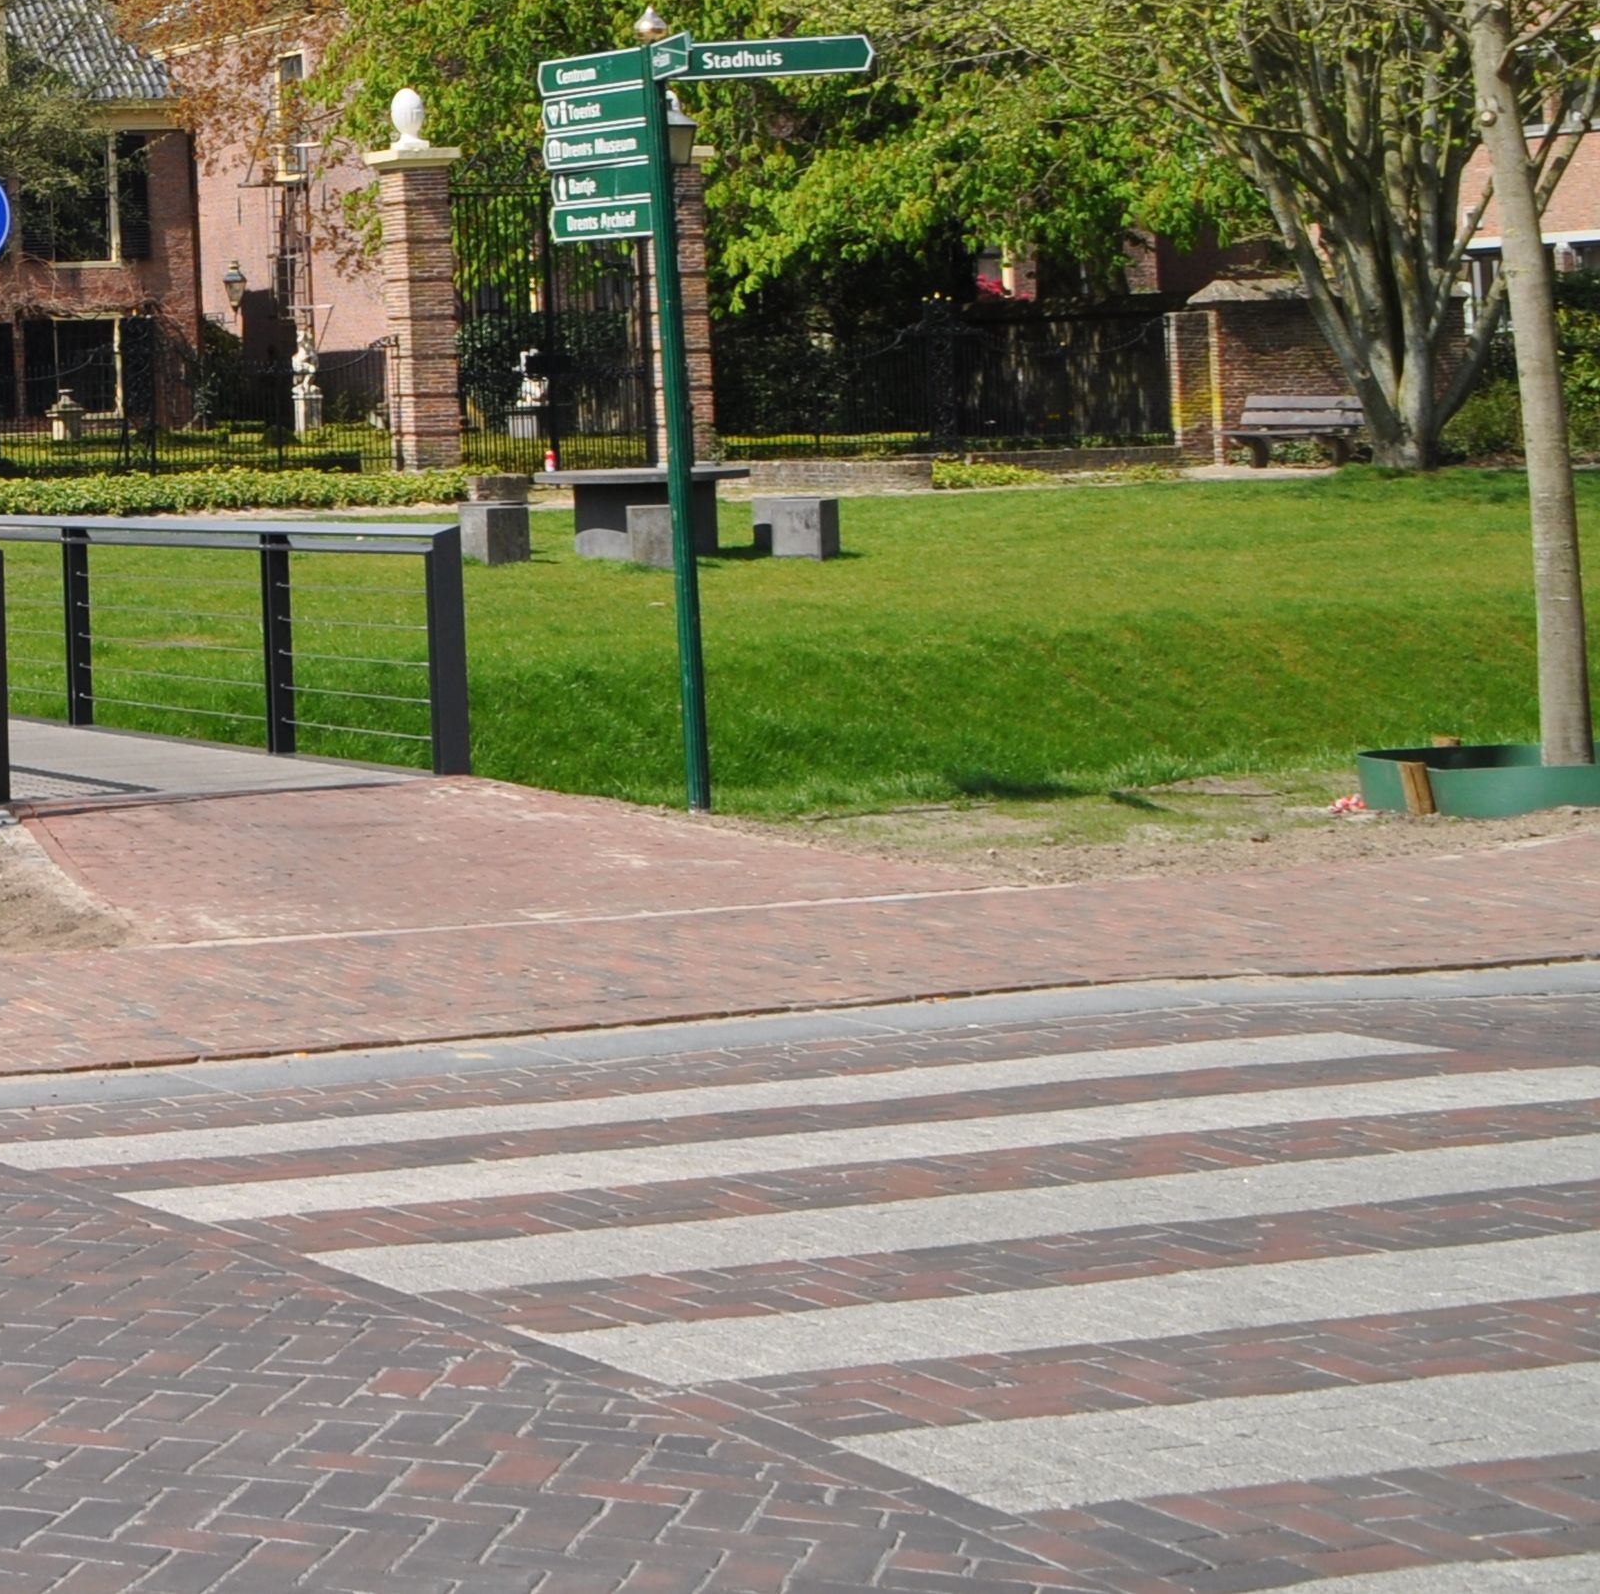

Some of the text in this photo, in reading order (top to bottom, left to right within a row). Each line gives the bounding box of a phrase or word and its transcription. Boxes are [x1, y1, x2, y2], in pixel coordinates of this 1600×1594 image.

[701, 49, 783, 70] Stadhuis
[555, 67, 597, 85] Centrum
[562, 137, 638, 158] Drents Museum
[566, 209, 637, 232] Drents Archief
